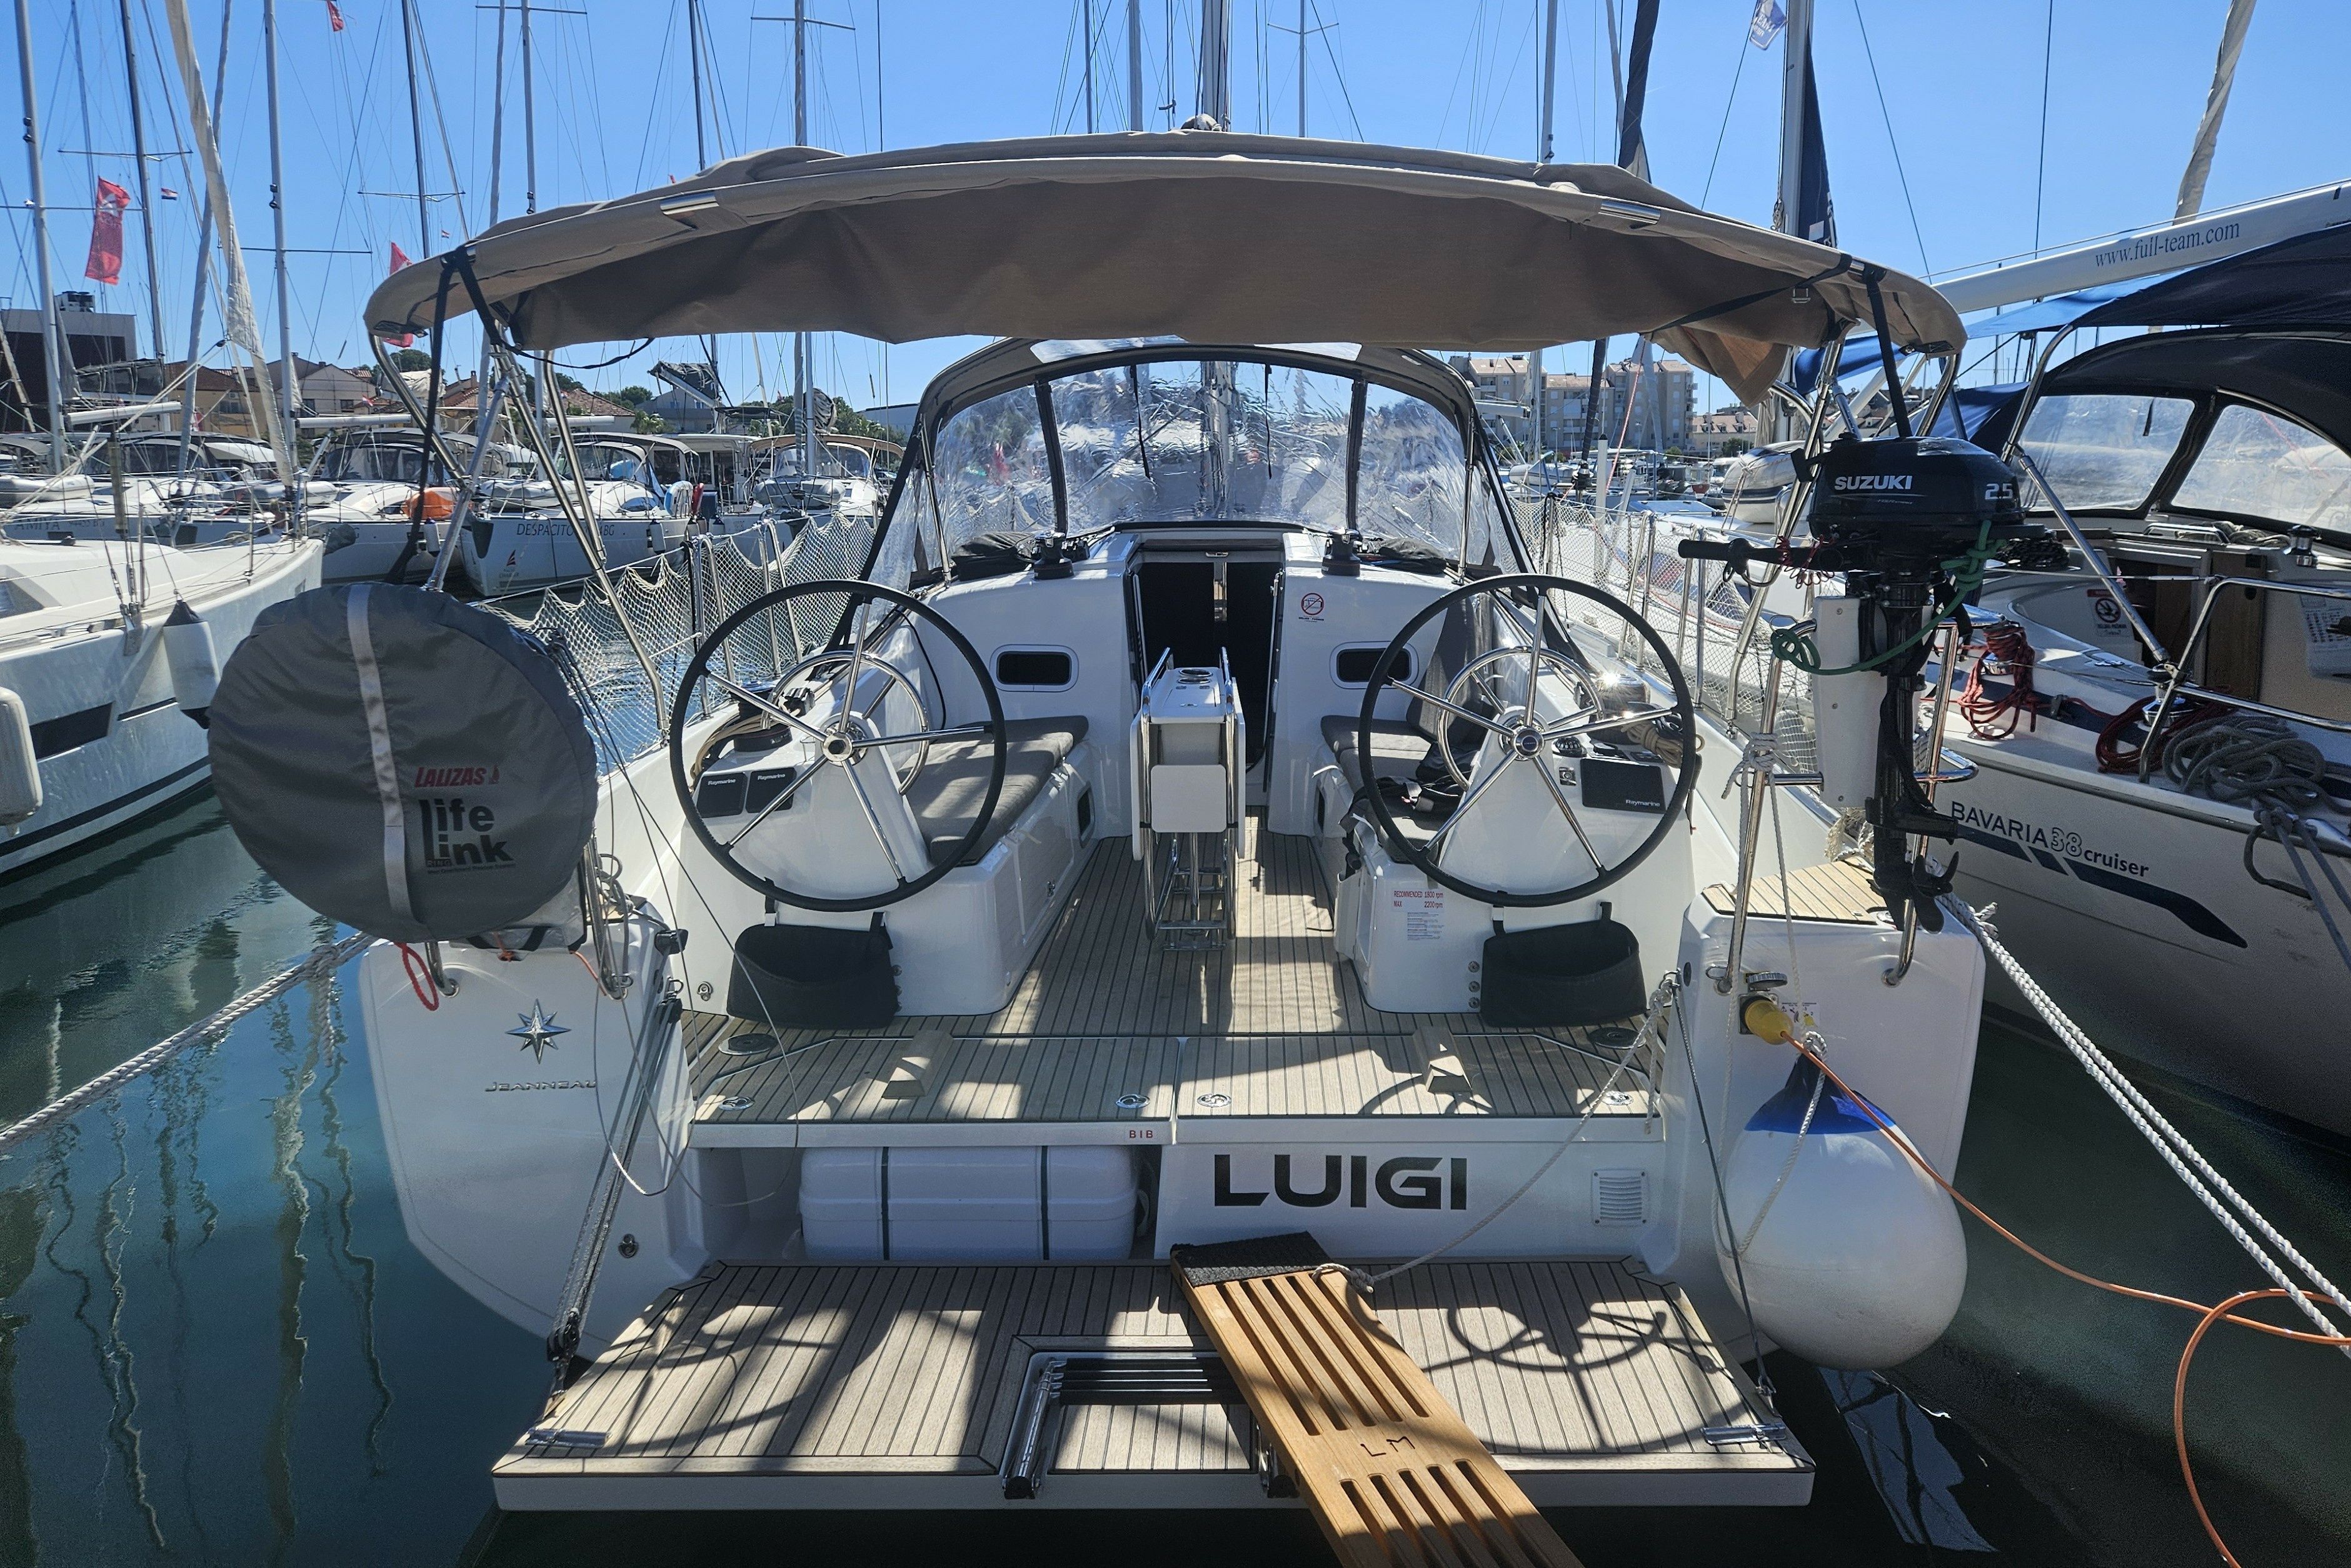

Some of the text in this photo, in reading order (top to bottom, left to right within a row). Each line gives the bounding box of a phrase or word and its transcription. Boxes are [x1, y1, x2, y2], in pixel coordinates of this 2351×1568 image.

[1834, 476, 1913, 491] SUZUKI
[516, 523, 573, 536] DESPACITO
[1625, 799, 1660, 807] Raymarine
[1951, 801, 2150, 877] BAVARIA 38 cruiser
[485, 1081, 596, 1092] JEANNEAU
[1129, 1129, 1154, 1139] BIB
[1215, 1154, 1467, 1210] LUIGI
